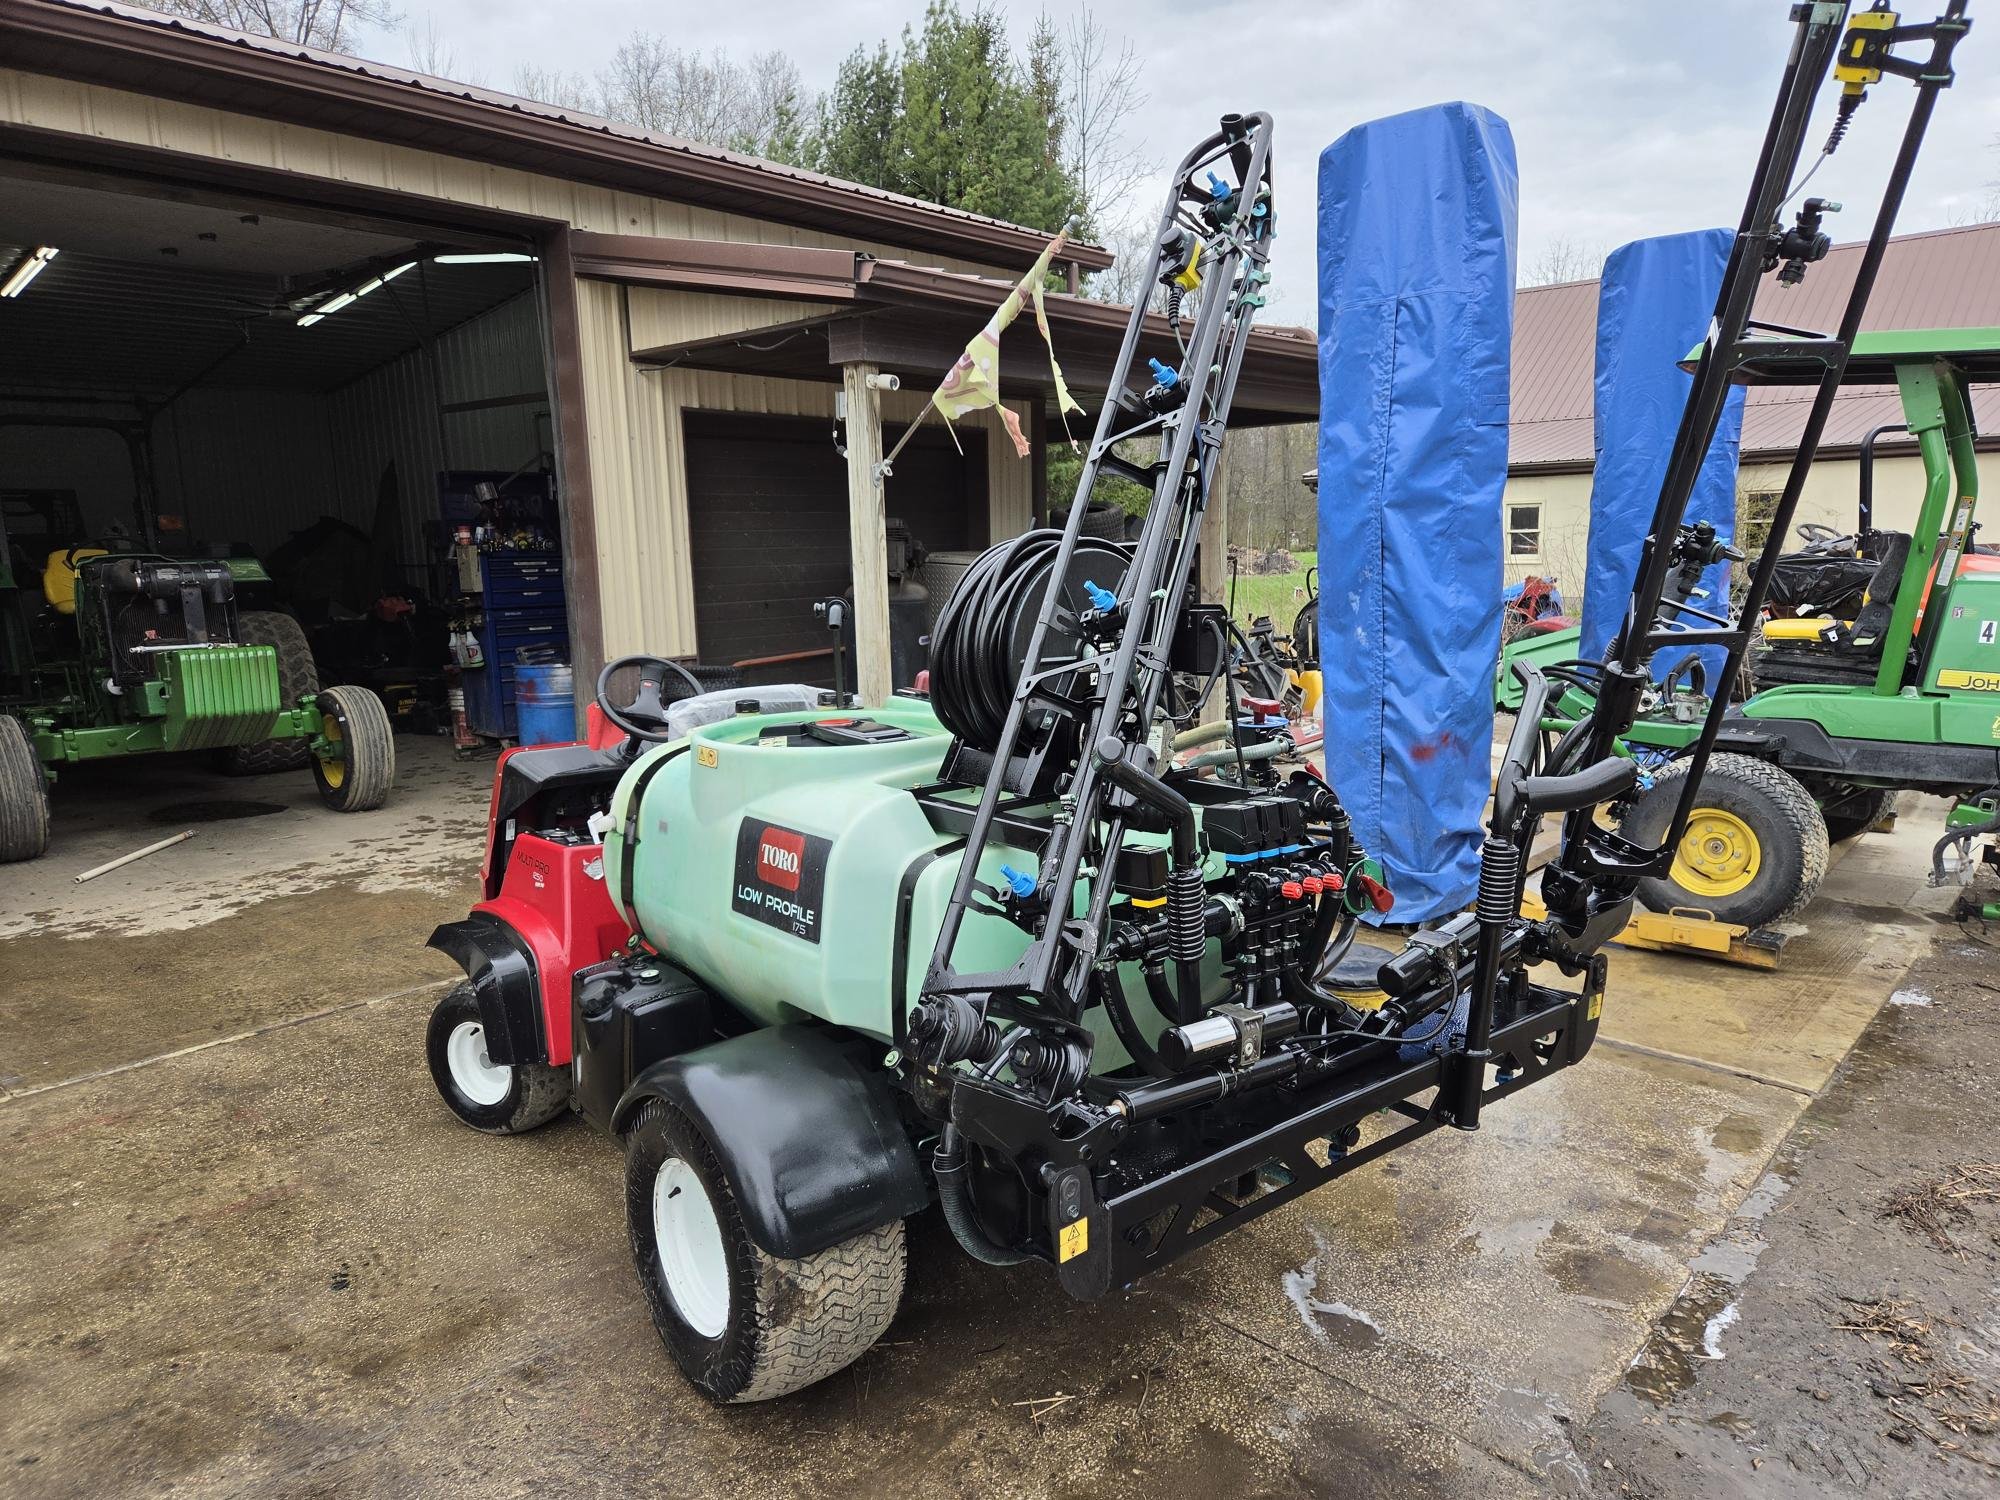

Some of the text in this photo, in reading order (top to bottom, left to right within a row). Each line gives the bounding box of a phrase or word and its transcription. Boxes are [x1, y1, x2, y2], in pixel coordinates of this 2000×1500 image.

[1981, 622, 1994, 642] 4
[535, 859, 550, 874] PRO
[761, 843, 799, 873] TORO
[738, 884, 815, 925] LOW PROFILE
[792, 921, 806, 935] 175
